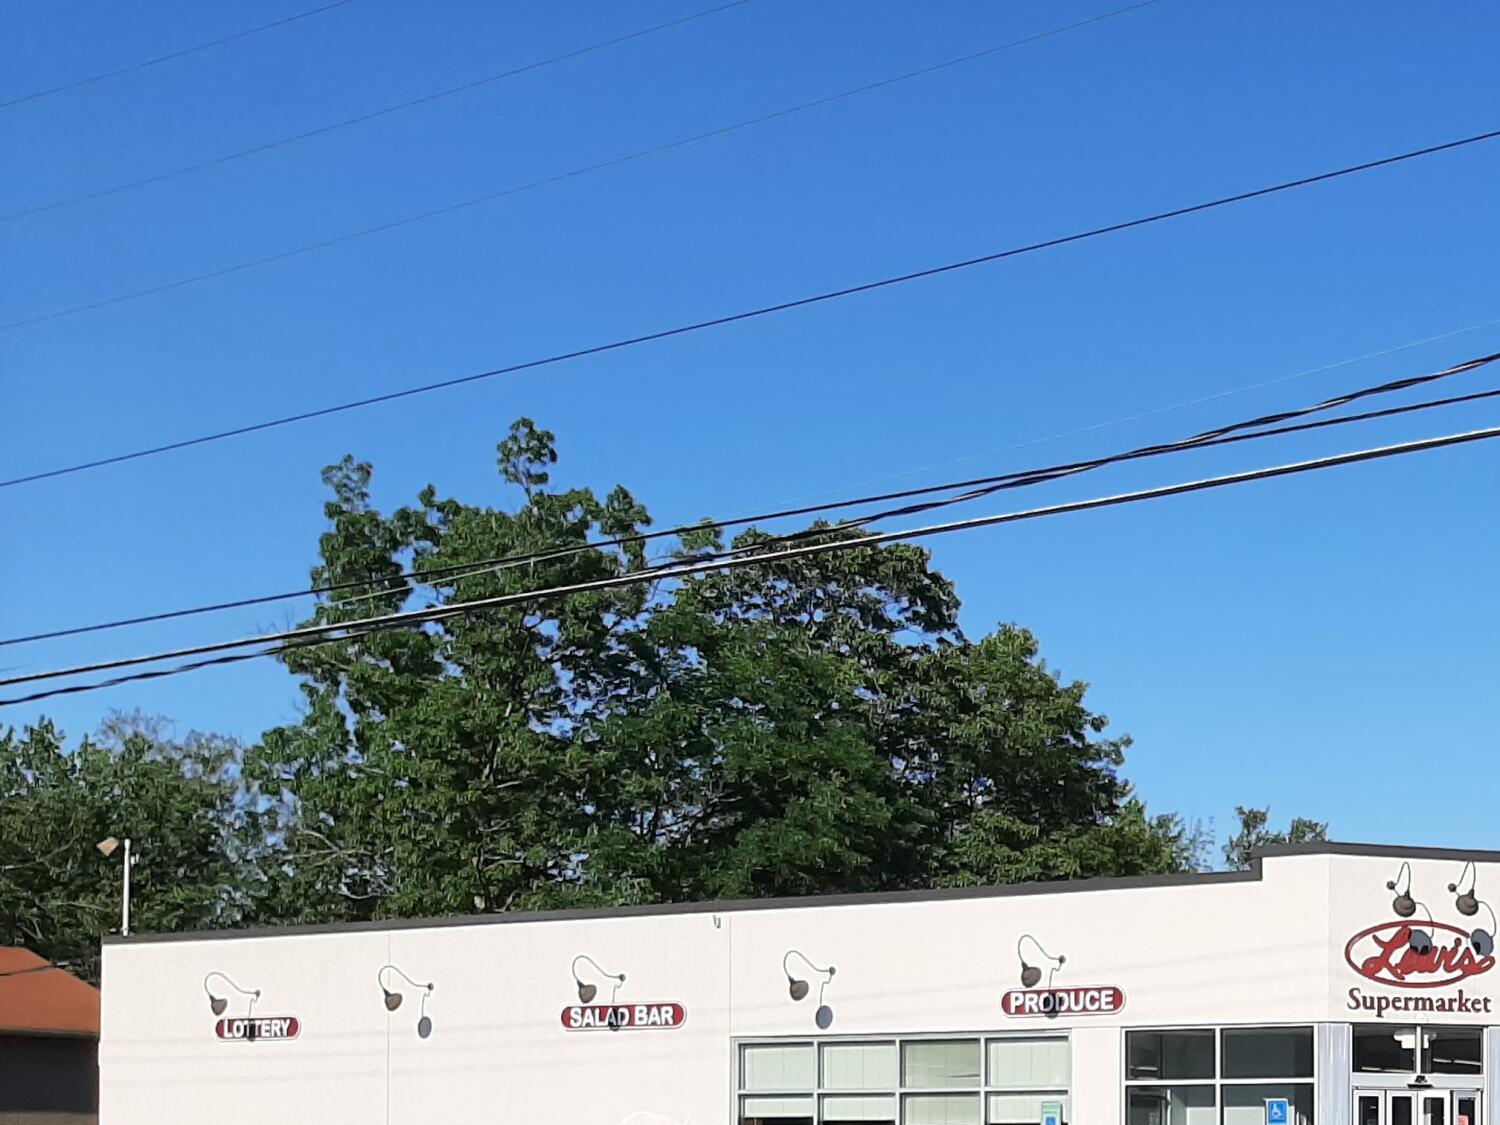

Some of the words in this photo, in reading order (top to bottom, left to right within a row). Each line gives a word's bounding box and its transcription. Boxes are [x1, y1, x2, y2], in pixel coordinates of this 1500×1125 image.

[1009, 990, 1114, 1013] PRODUCE
[1347, 987, 1491, 1018] Supermarket
[569, 1007, 630, 1027] SALAD
[634, 1005, 674, 1025] BAR
[223, 1018, 291, 1039] LOTTERY
